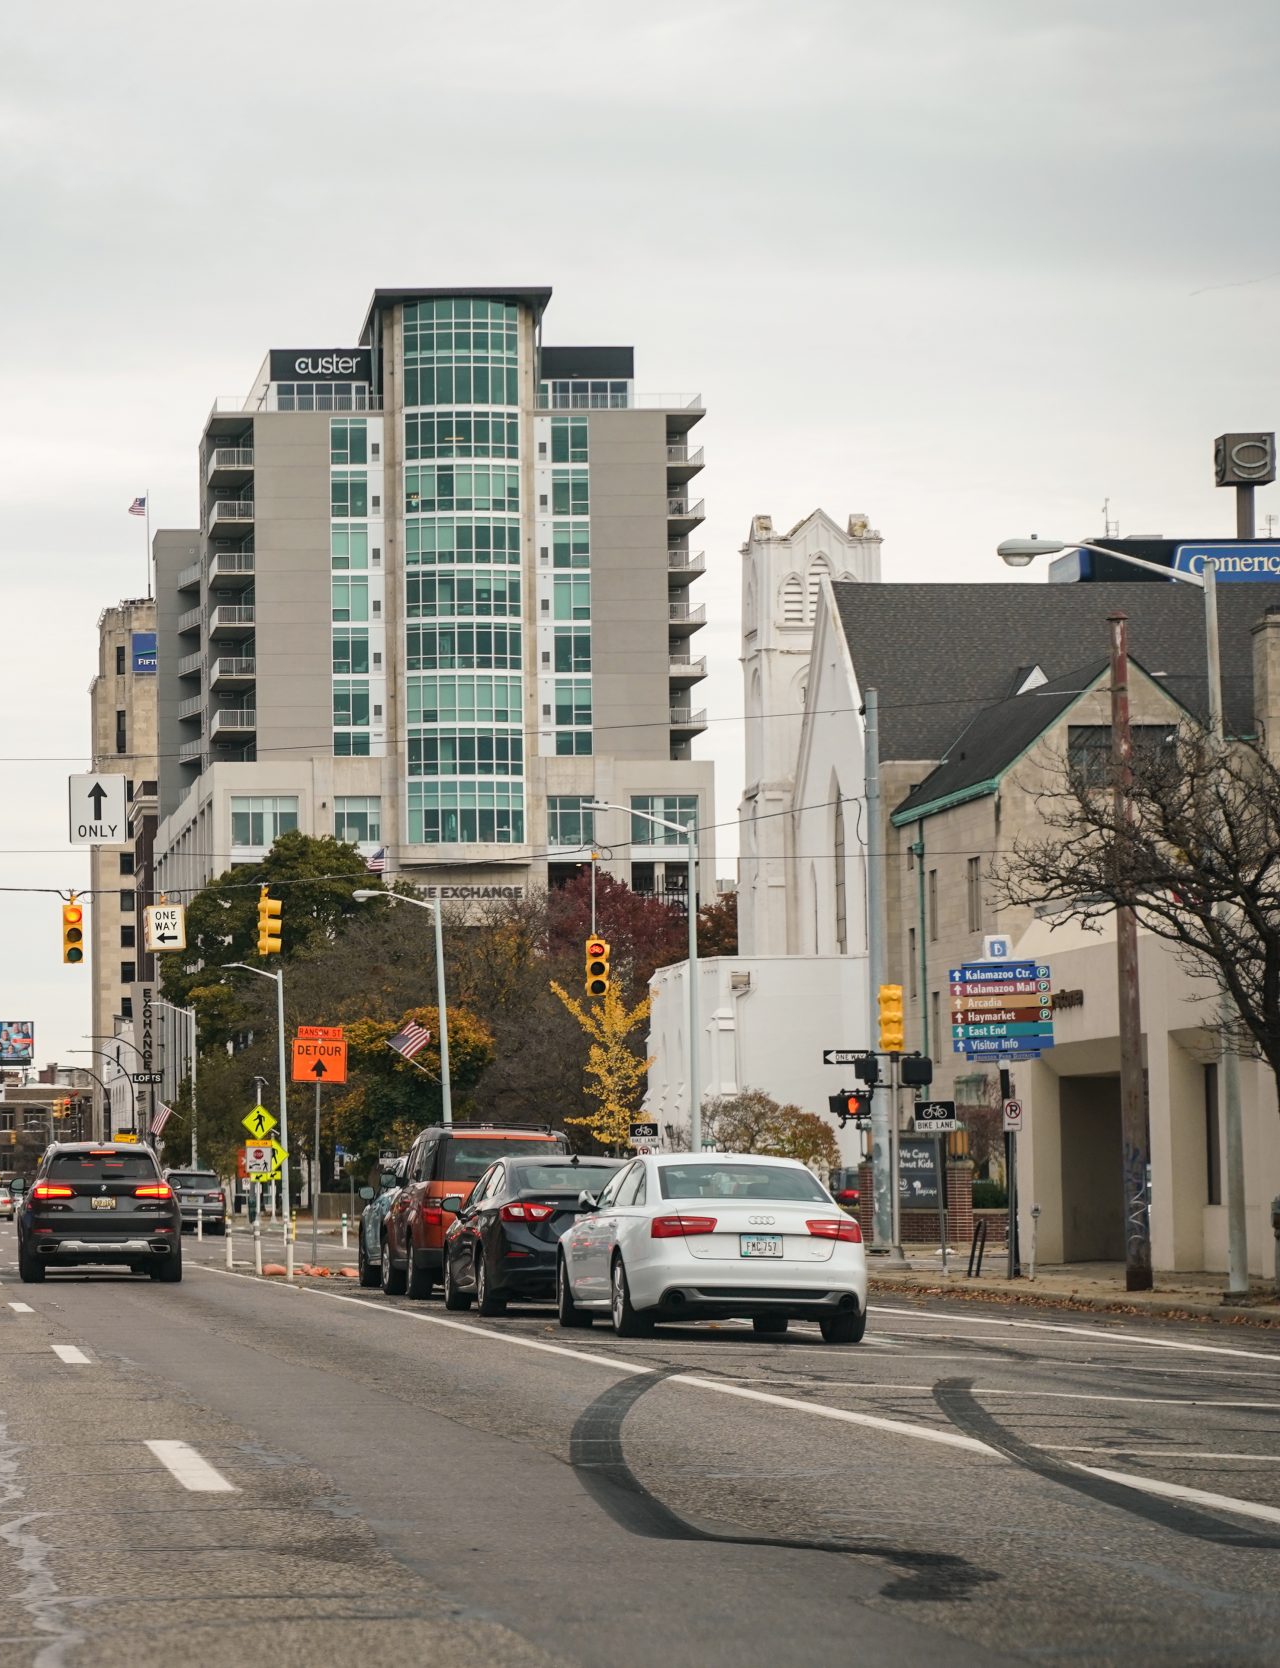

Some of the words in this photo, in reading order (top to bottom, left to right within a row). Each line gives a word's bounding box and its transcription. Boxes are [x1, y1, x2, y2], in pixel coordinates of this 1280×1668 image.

[295, 353, 361, 374] custer
[78, 825, 118, 838] ONLY
[417, 887, 437, 898] HE
[441, 886, 523, 899] EXCHANGE
[155, 911, 176, 920] ONE
[155, 921, 178, 931] WAY
[965, 970, 1013, 980] Kalamazoo
[1016, 968, 1033, 978] Ctr.
[966, 984, 1014, 994] Kalamazoo
[1017, 982, 1036, 992] Mall
[967, 997, 1002, 1008] Arcadia
[967, 1010, 1016, 1022] Haymarket
[143, 988, 153, 1071] EXCHANGE
[298, 1027, 329, 1037] RANSOM
[332, 1029, 341, 1038] ST
[968, 1026, 988, 1036] East
[990, 1025, 1007, 1035] End
[297, 1044, 342, 1056] DETOUR
[971, 1039, 999, 1050] Visitor
[1001, 1038, 1019, 1049] Info
[917, 1121, 933, 1130] BIKE
[935, 1120, 954, 1129] LANE
[912, 1149, 929, 1158] Care
[918, 1158, 934, 1169] Kids
